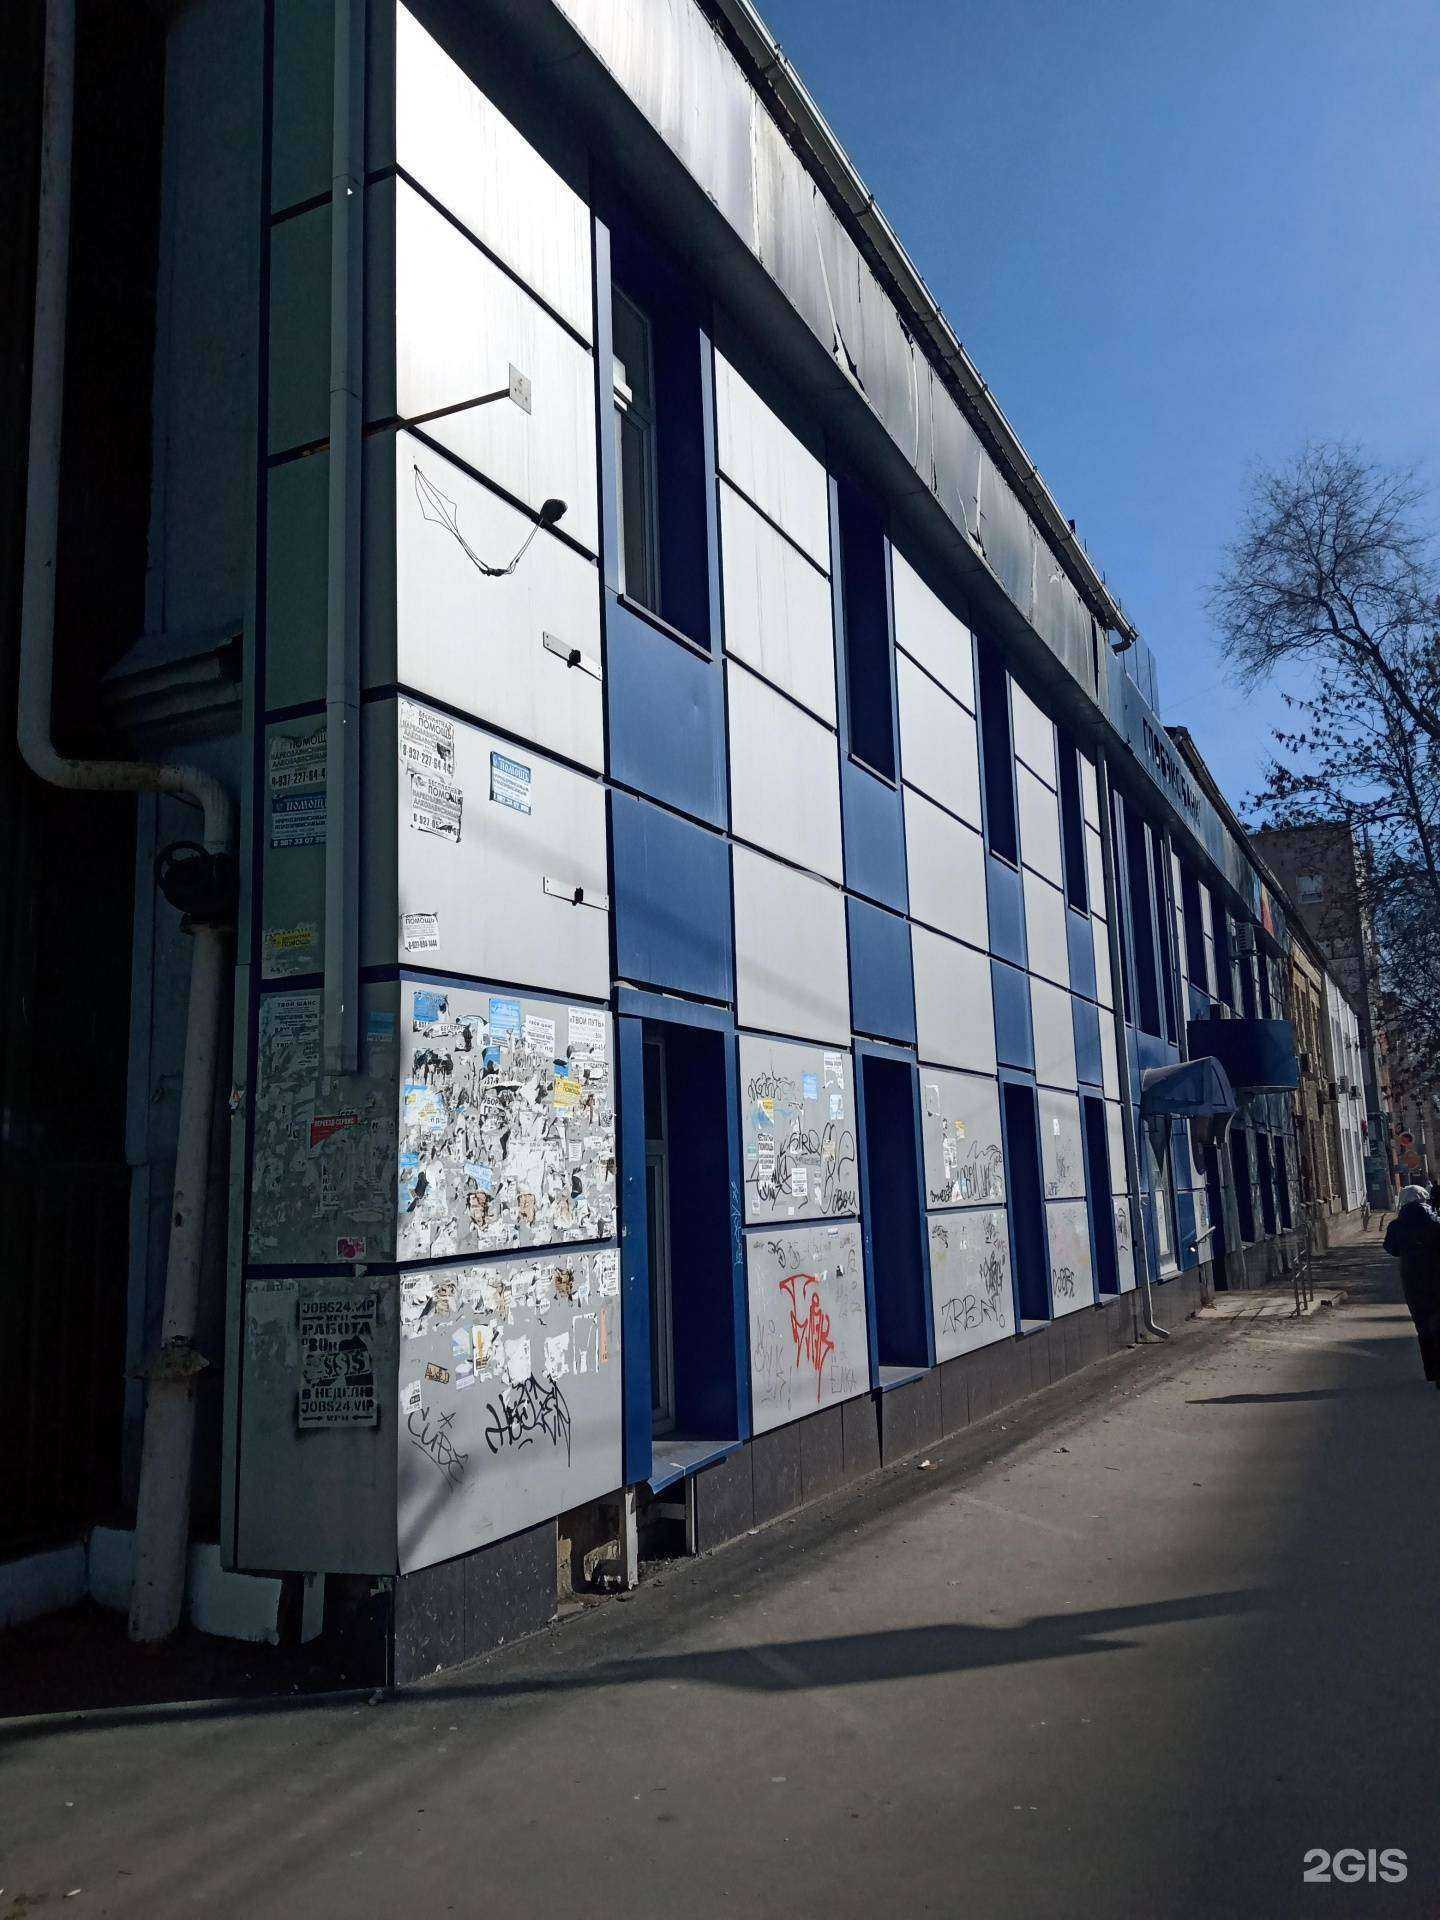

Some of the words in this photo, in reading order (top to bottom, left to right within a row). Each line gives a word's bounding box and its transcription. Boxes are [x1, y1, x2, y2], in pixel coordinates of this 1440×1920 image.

[290, 735, 327, 750] ПОМОЩ
[302, 1321, 371, 1336] РАБОТА
[301, 1399, 375, 1413] JOBS24.VIP
